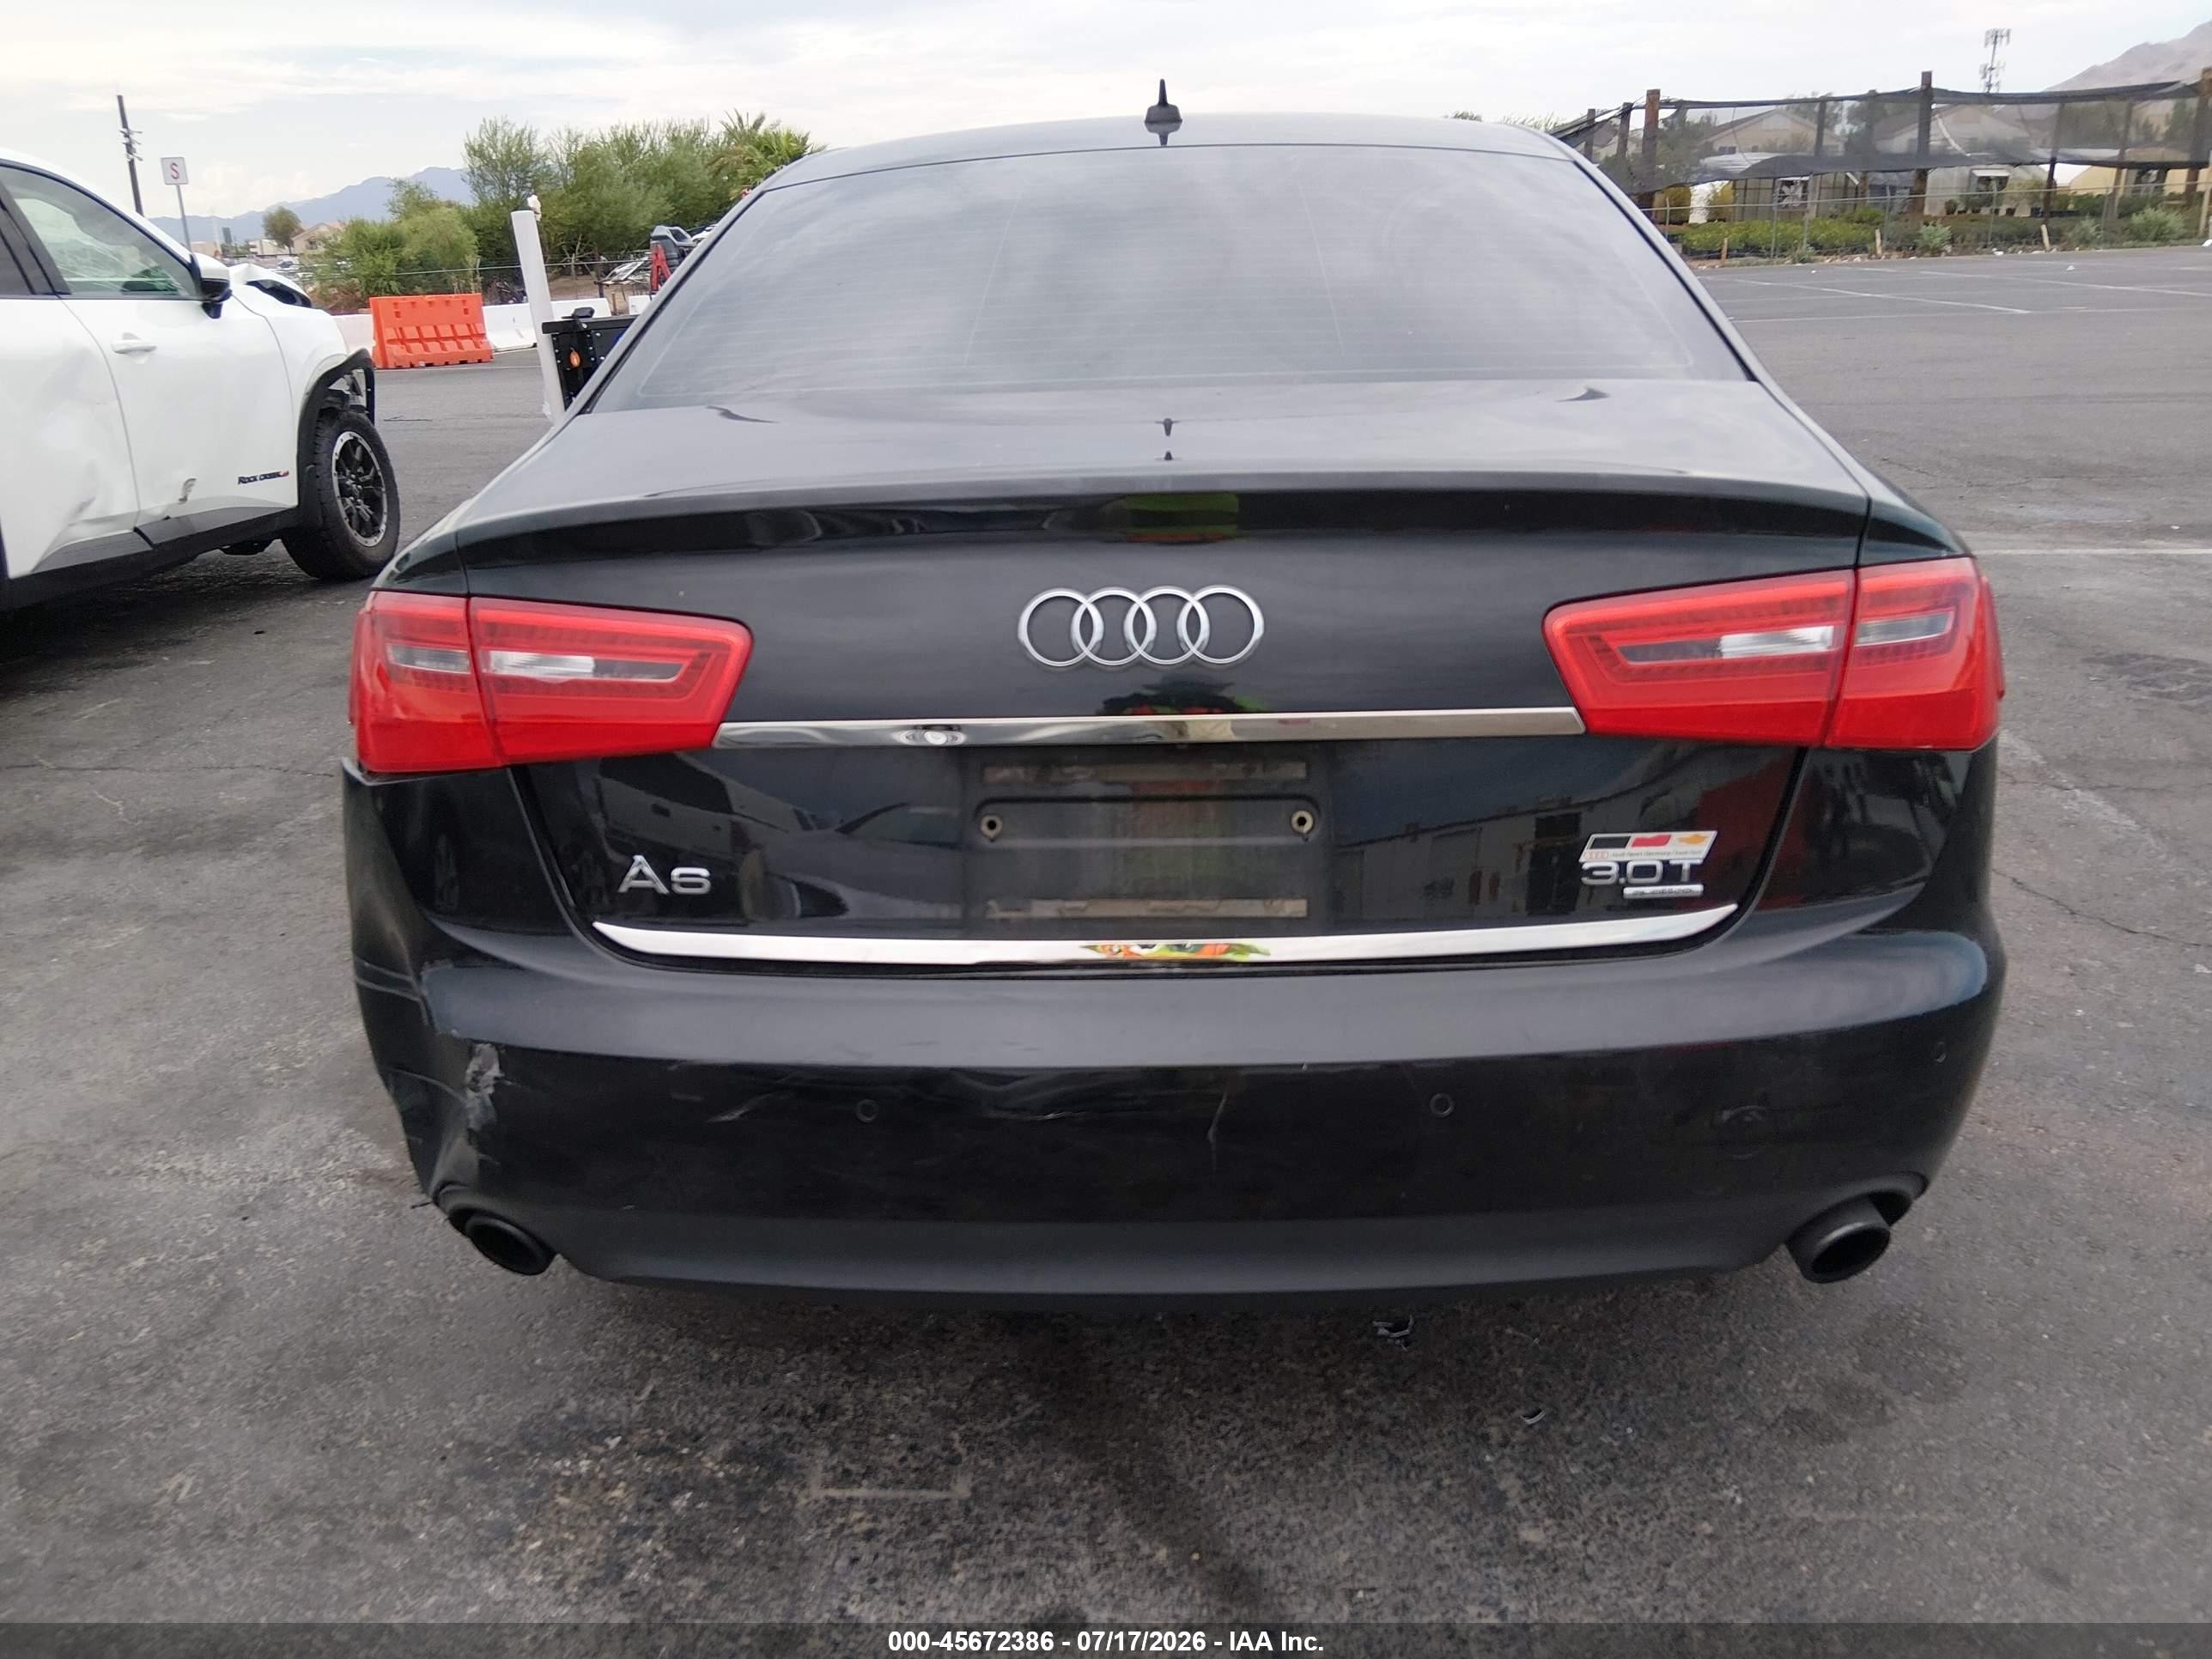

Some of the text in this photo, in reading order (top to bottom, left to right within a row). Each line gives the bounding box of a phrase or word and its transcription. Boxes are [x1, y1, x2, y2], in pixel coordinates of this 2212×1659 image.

[170, 162, 179, 180] S
[617, 854, 711, 894] A6
[1581, 860, 1702, 885] 3.0T
